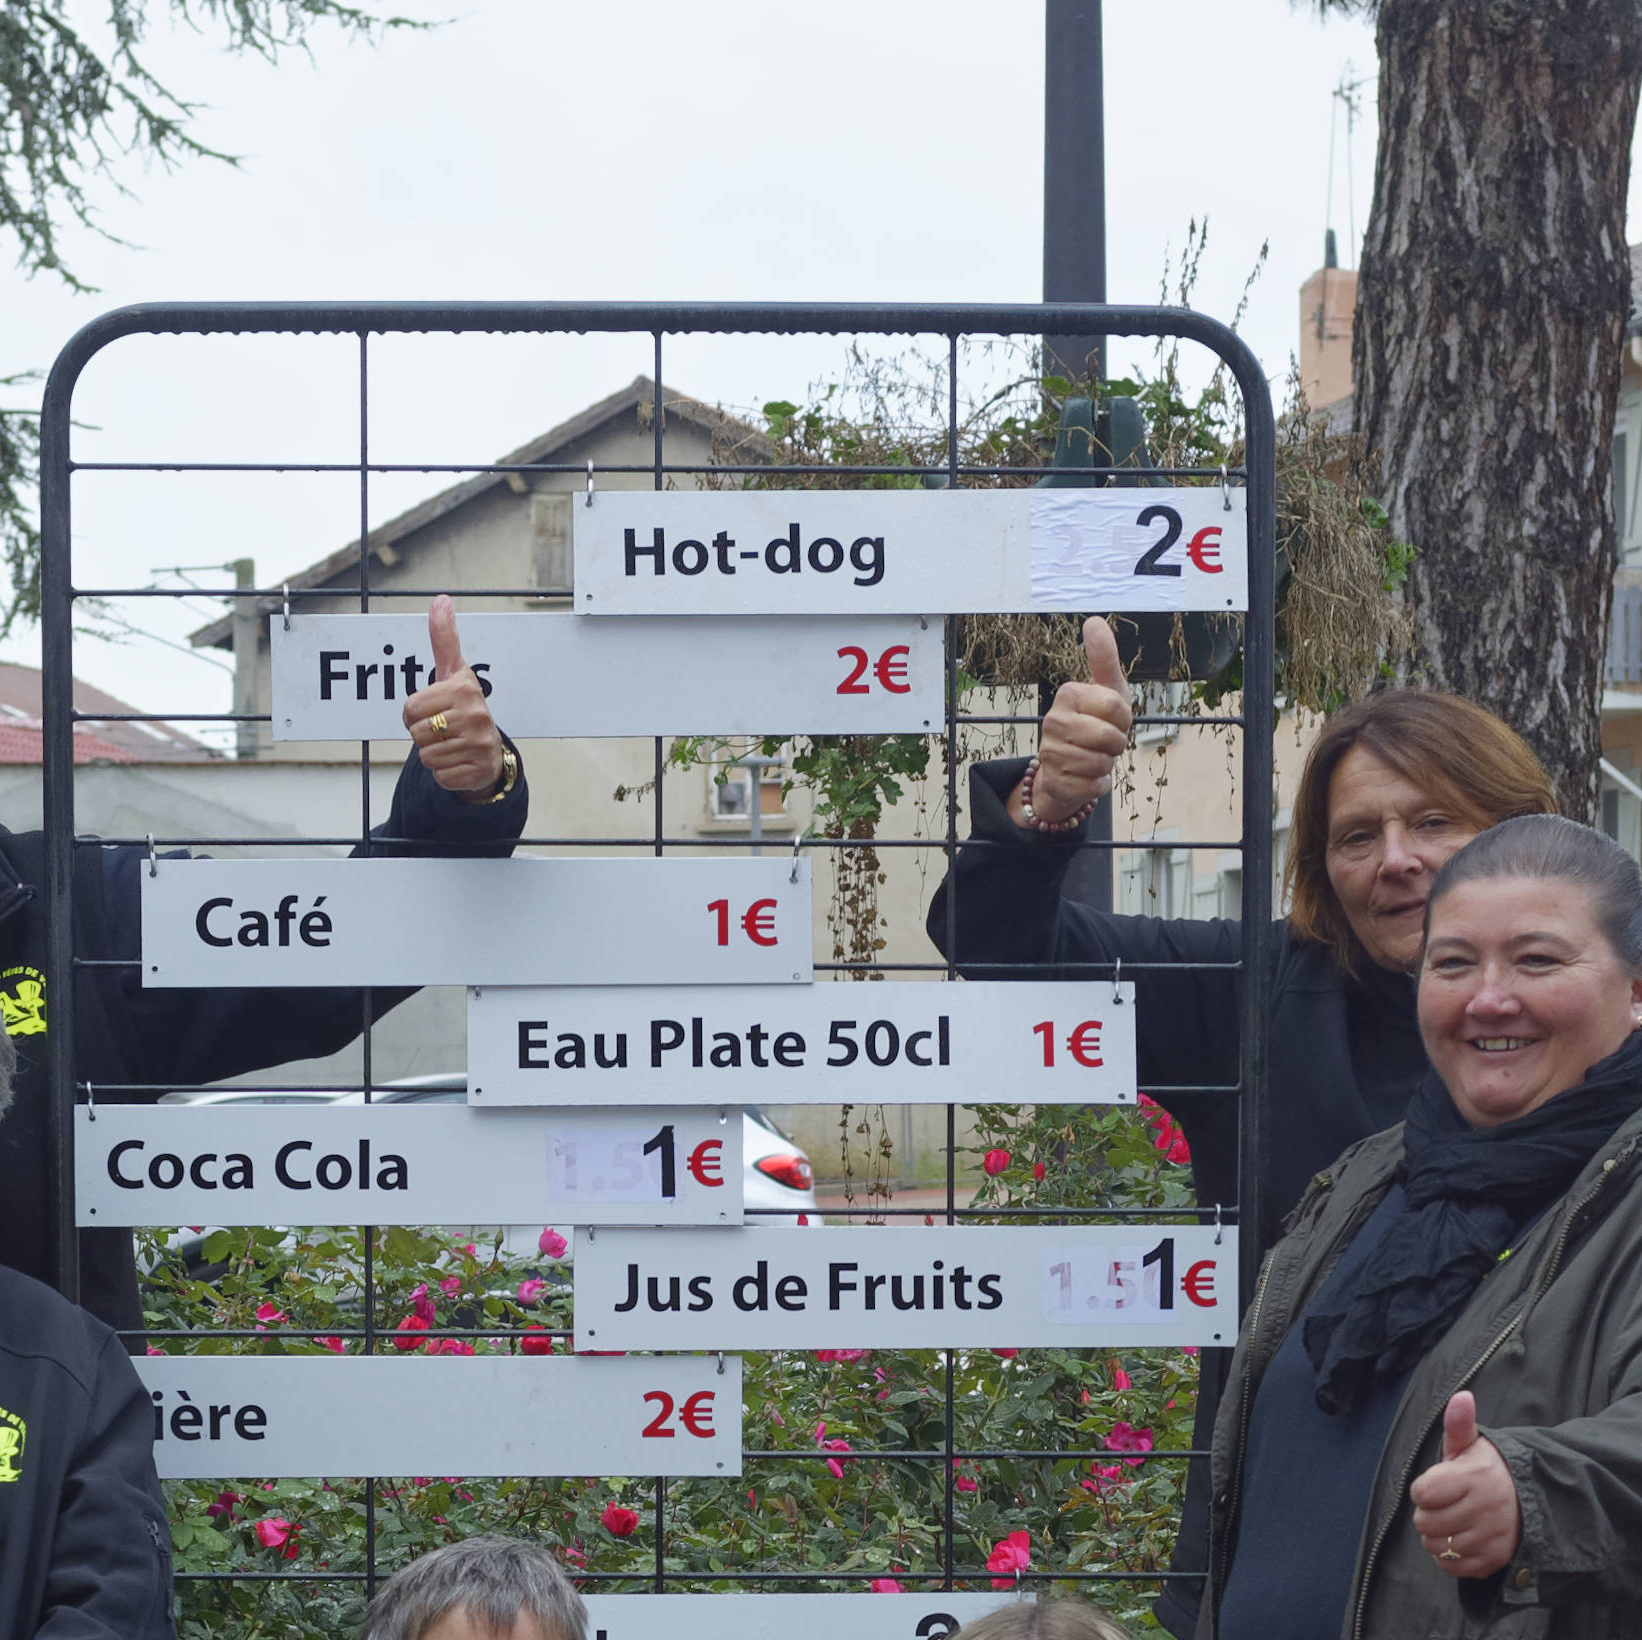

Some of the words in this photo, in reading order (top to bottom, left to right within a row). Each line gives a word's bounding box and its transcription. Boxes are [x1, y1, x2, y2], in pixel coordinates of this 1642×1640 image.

[624, 523, 885, 586] Hot-dog
[1133, 504, 1224, 577] 2€
[319, 643, 494, 700] Frits
[836, 645, 910, 694] 2€
[195, 895, 333, 947] Café
[707, 898, 778, 946] 1€
[518, 1021, 628, 1069] Eau
[650, 1017, 806, 1068] Plate
[826, 1016, 950, 1067] 50cl
[1033, 1020, 1103, 1067] 1€
[107, 1139, 254, 1190] Coca
[275, 1139, 408, 1191] Cola
[643, 1125, 725, 1197] 1€
[614, 1263, 714, 1312] Jus
[732, 1260, 808, 1312] de
[829, 1260, 1003, 1311] Fruits
[1142, 1237, 1218, 1310] 1€
[151, 1390, 267, 1441] ière
[642, 1390, 716, 1438] 2€
